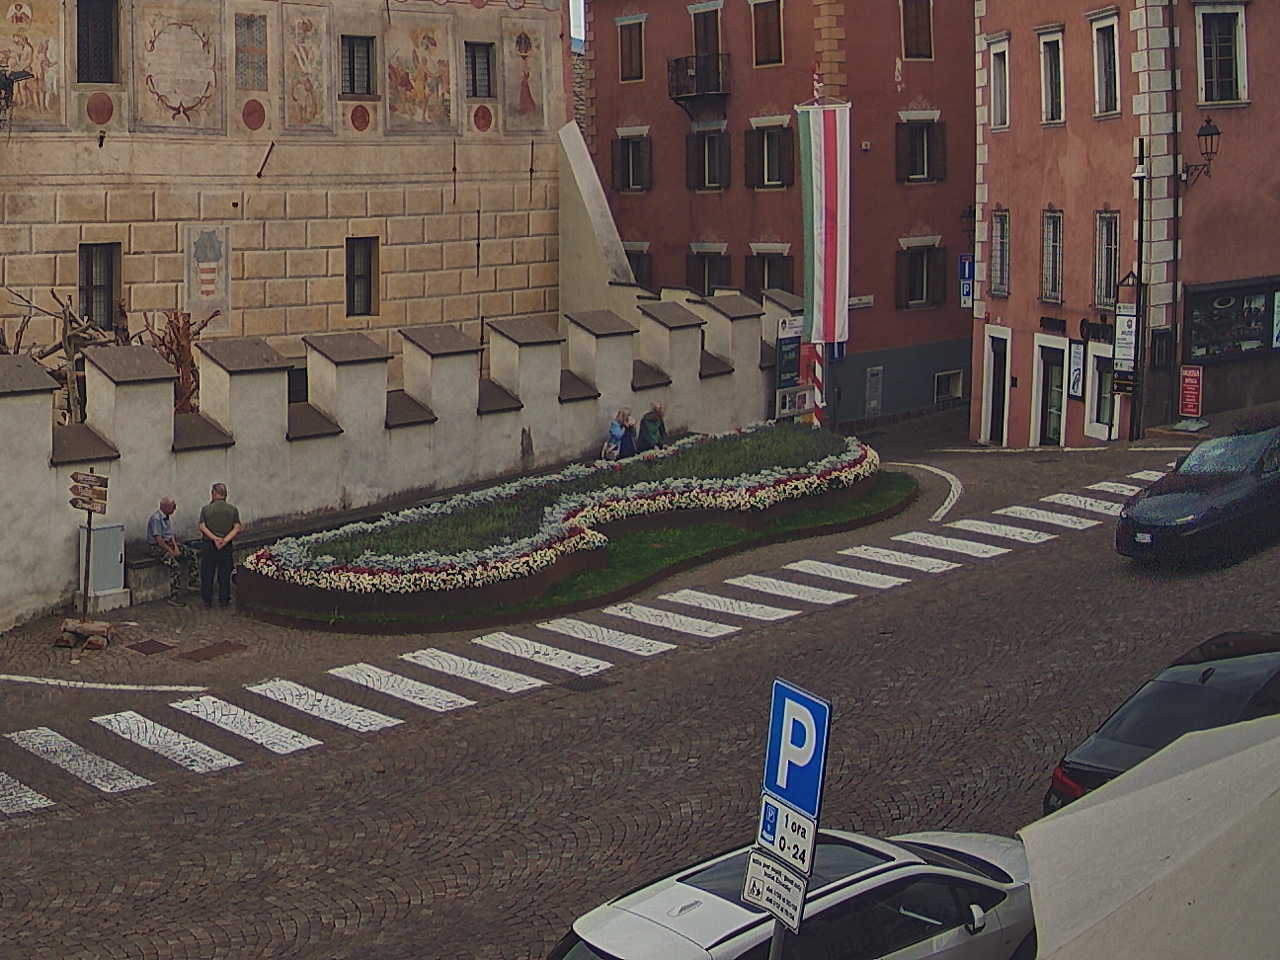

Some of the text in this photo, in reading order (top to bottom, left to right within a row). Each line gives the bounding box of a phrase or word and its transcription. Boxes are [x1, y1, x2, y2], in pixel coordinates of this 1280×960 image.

[776, 697, 817, 790] P
[784, 813, 807, 840] 1 ora
